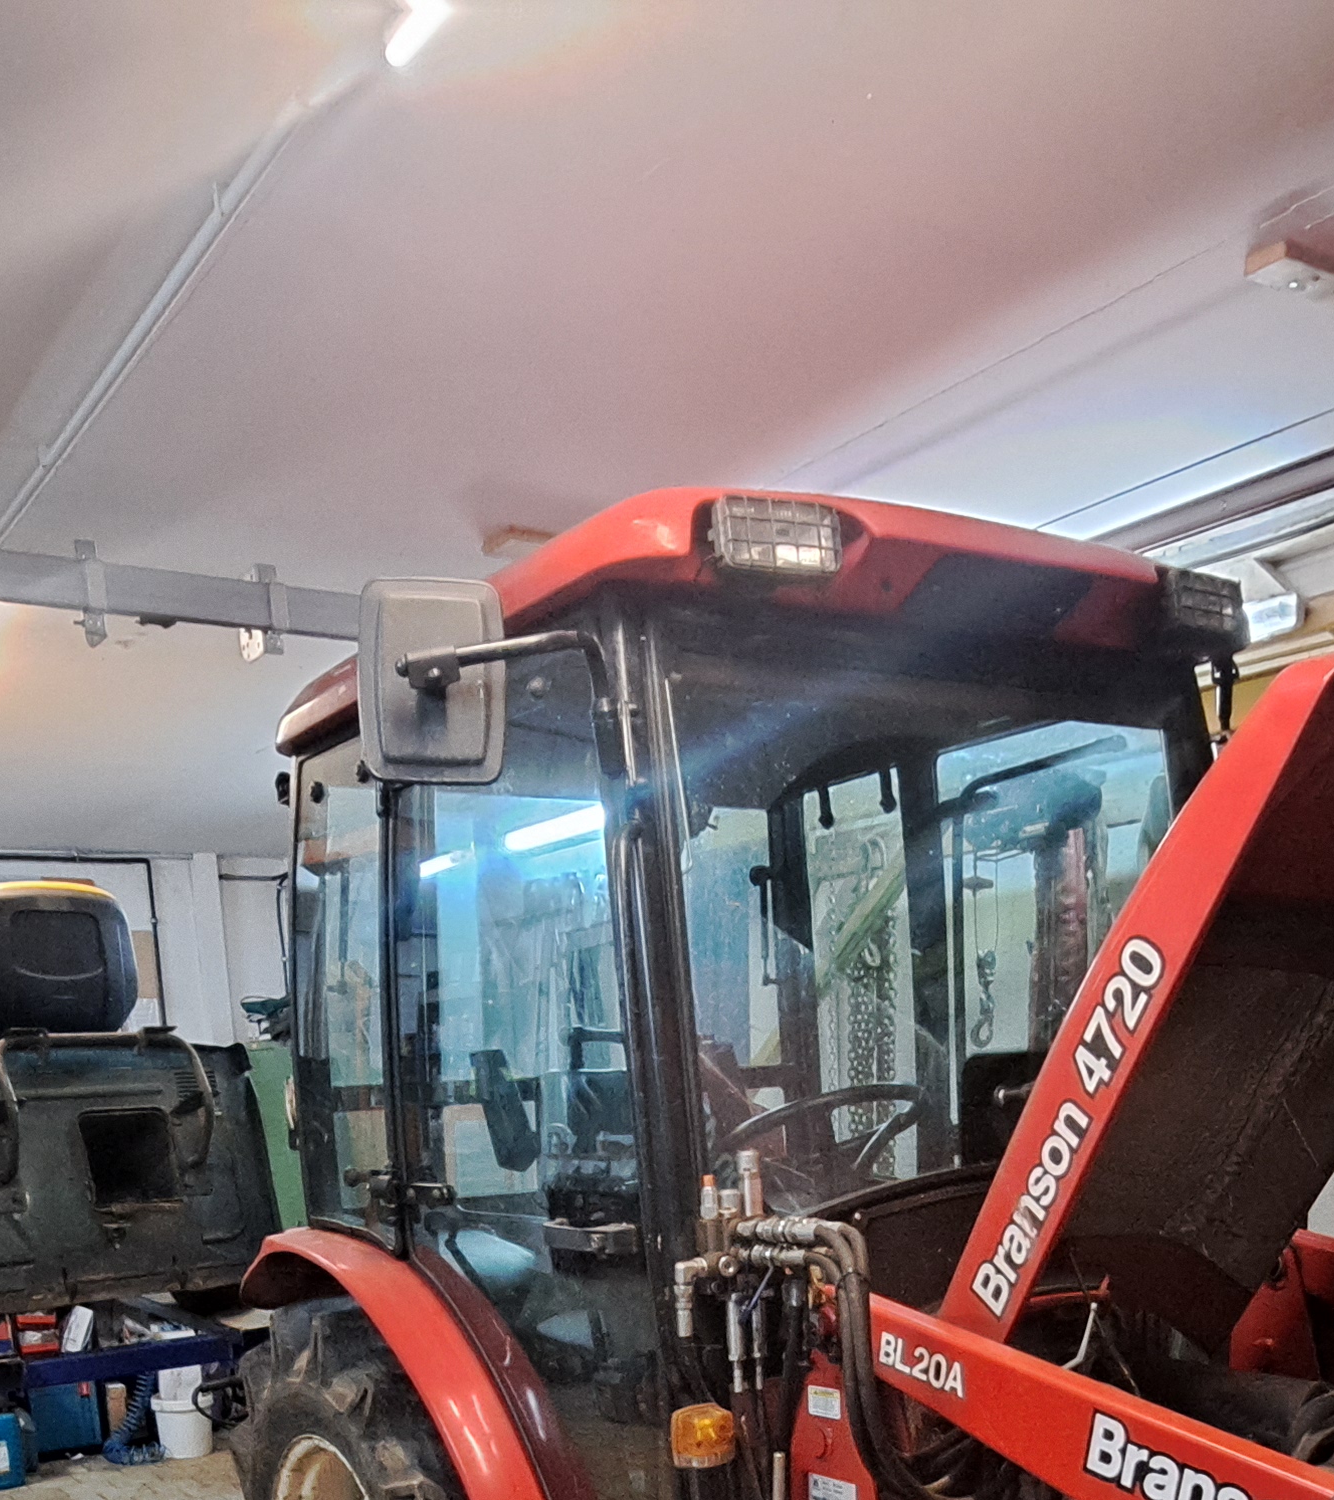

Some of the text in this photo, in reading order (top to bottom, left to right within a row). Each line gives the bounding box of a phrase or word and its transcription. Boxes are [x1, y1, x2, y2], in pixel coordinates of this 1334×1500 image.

[972, 937, 1164, 1317] Branson 4720
[879, 1331, 964, 1399] BL20A
